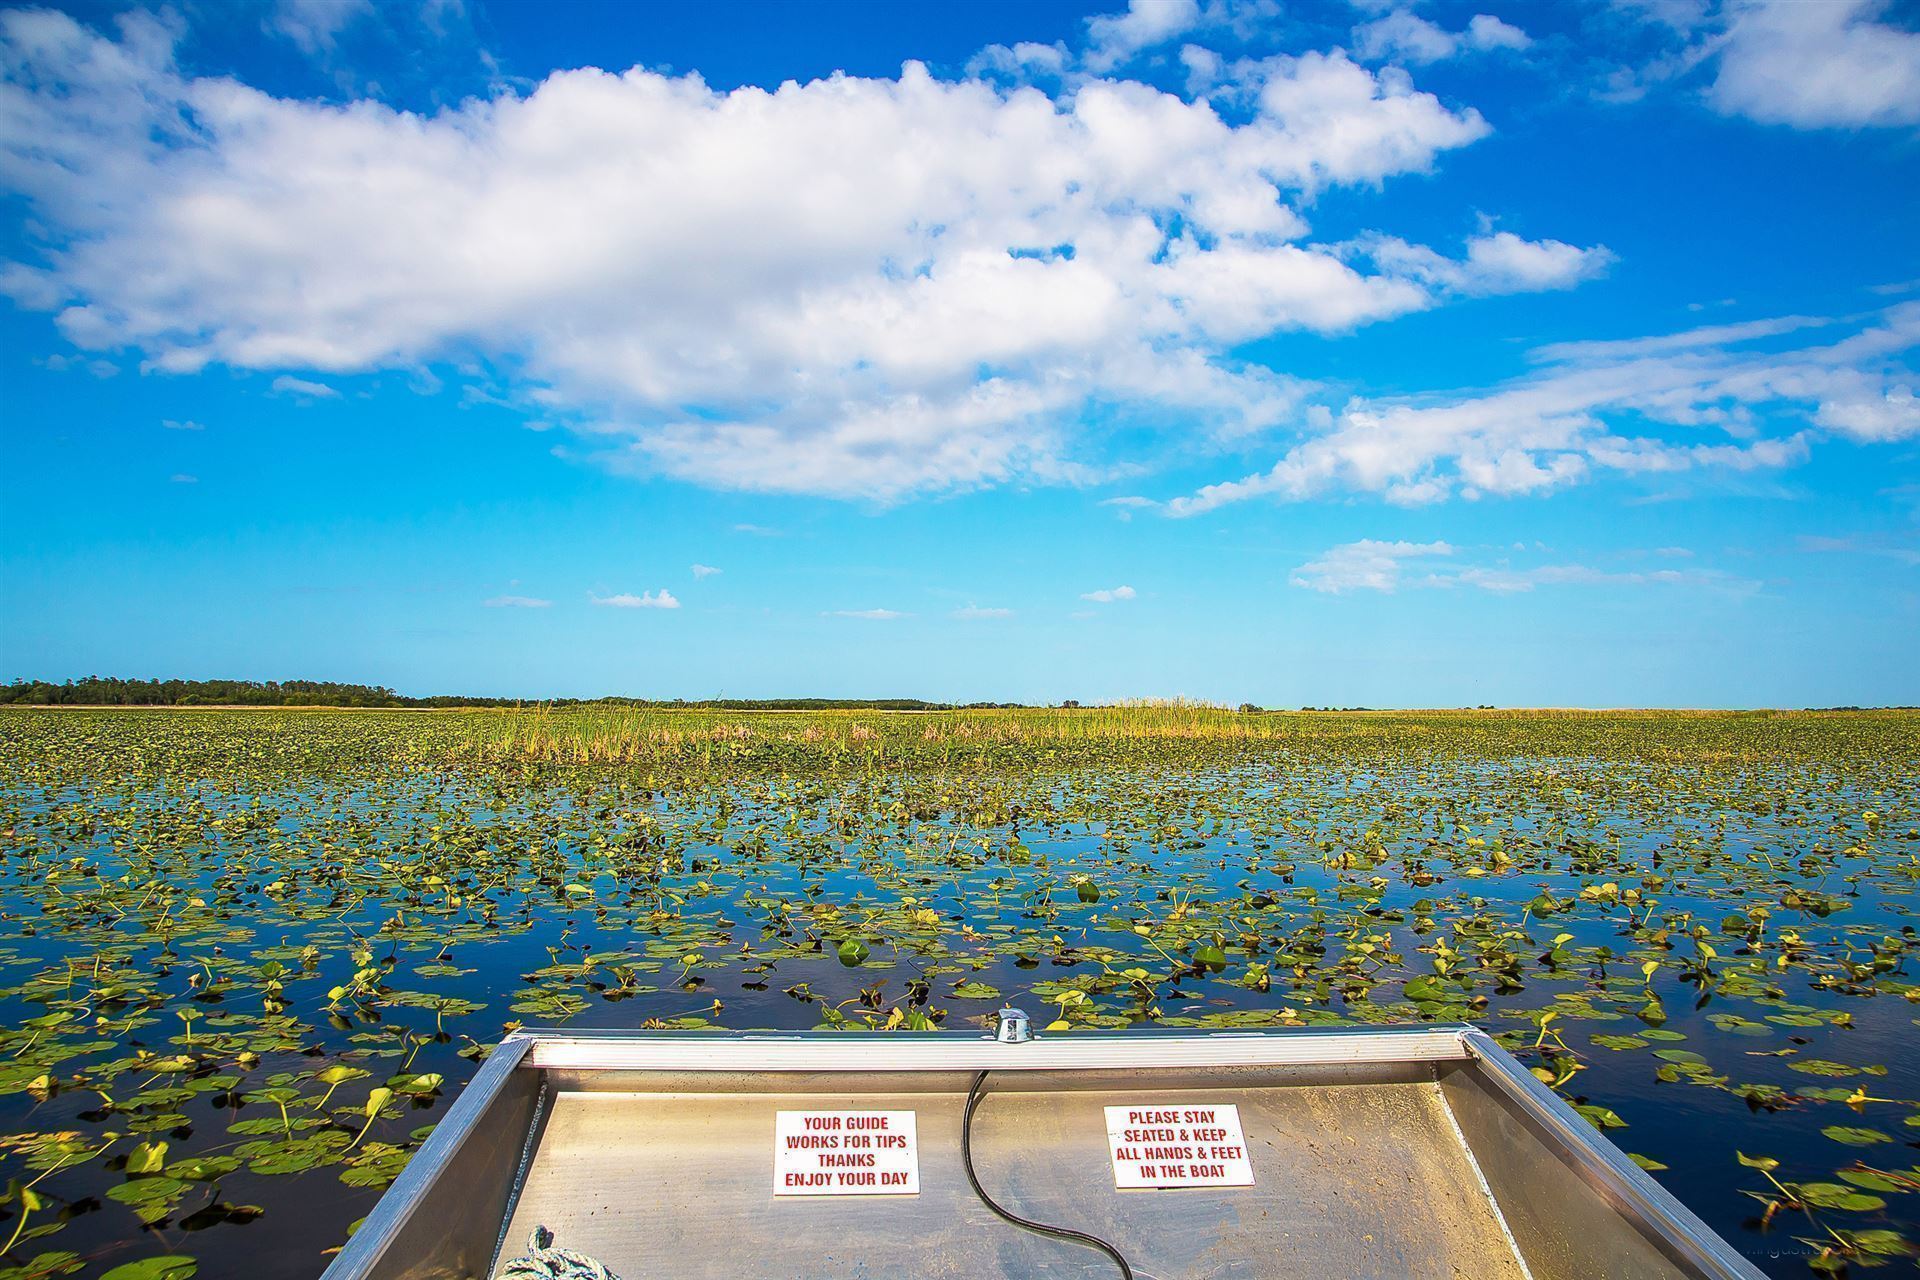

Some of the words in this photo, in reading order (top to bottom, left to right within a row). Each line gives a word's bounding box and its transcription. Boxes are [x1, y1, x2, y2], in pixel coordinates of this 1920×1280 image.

[805, 1117, 840, 1130] YOUR
[847, 1117, 888, 1129] GUIDE
[1130, 1112, 1180, 1124] PLEASE
[1184, 1111, 1214, 1123] STAY
[787, 1136, 838, 1148] WORKS
[844, 1136, 870, 1148] FOR
[876, 1136, 906, 1148] TIPS
[1124, 1129, 1174, 1142] SEATED
[1180, 1129, 1189, 1141] &
[1193, 1129, 1226, 1141] KEEP
[818, 1154, 875, 1166] THANKS
[1117, 1148, 1141, 1160] ALL
[1145, 1147, 1192, 1159] HANDS
[1198, 1147, 1207, 1159] &
[1211, 1147, 1241, 1159] FEET
[1141, 1166, 1156, 1178] IN
[1160, 1165, 1186, 1177] THE
[1190, 1165, 1224, 1177] BOAT
[786, 1173, 832, 1186] ENJOY
[838, 1173, 875, 1185] YOUR
[881, 1173, 908, 1185] DAY
